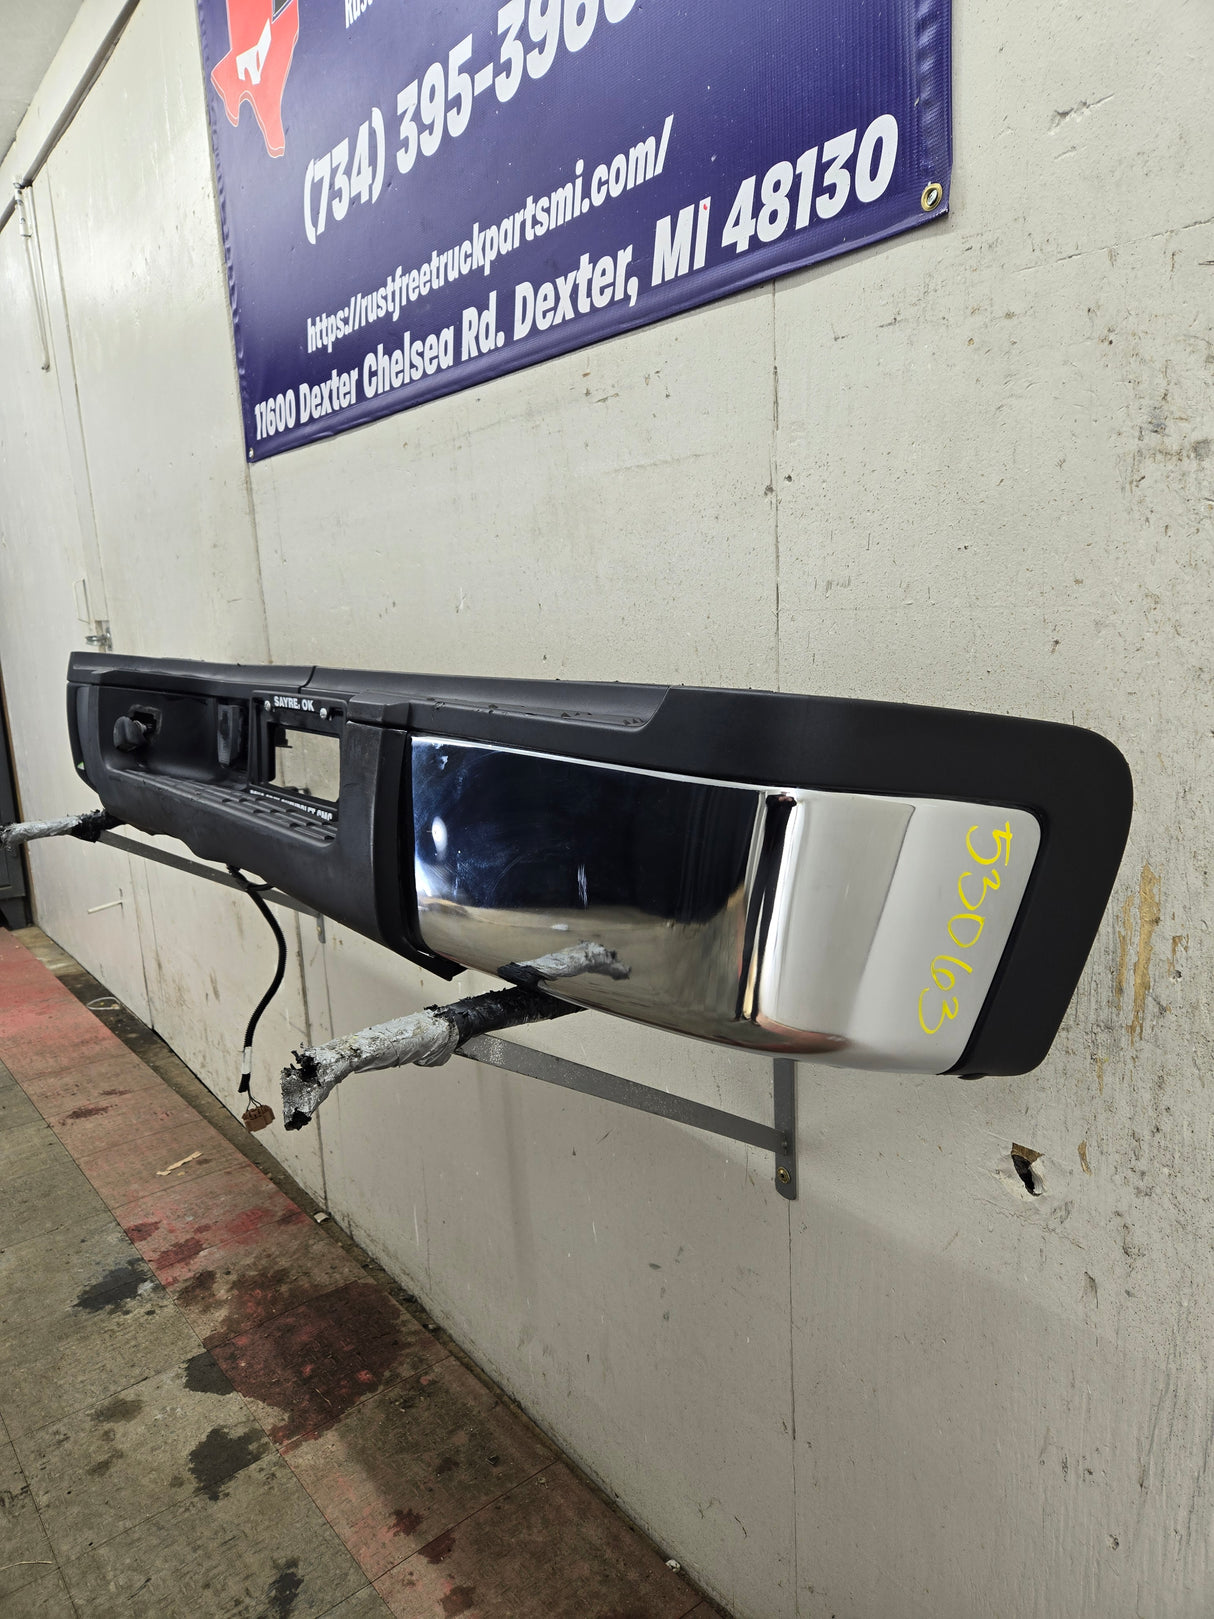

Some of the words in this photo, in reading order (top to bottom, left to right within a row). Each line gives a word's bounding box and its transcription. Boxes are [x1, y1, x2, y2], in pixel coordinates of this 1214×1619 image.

[303, 107, 386, 244] (734)
[396, 0, 637, 174] 395-396
[307, 113, 674, 354] https://rustfreetruckpartsmi.com/
[254, 389, 296, 440] 11600
[299, 369, 359, 424] Dexter
[363, 326, 455, 398] Chelsea
[461, 290, 505, 362] Rd.
[513, 245, 638, 341] Dexter,
[651, 196, 711, 287] MI
[721, 113, 899, 253] 48130
[301, 699, 315, 712] OK
[918, 821, 1013, 1034] 53063
